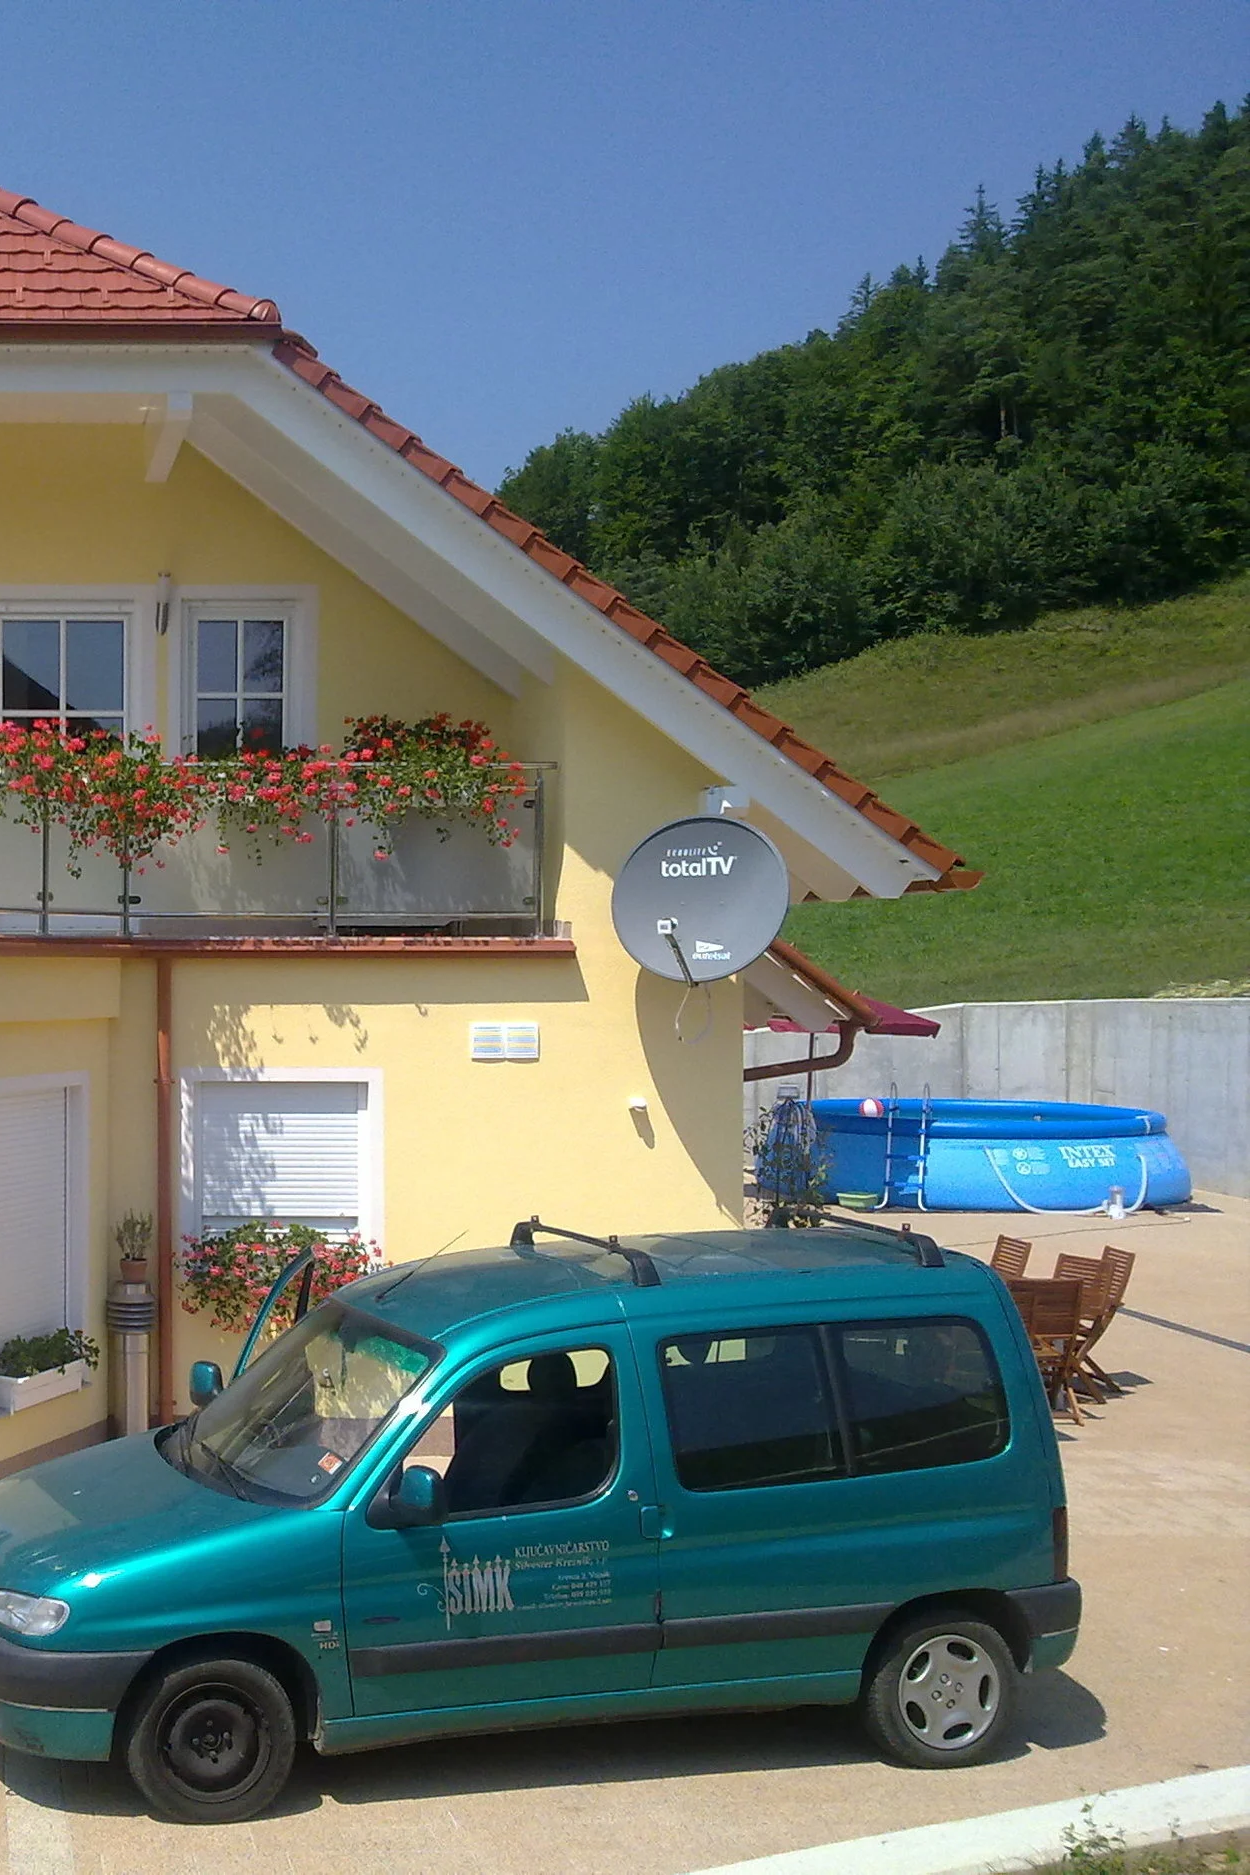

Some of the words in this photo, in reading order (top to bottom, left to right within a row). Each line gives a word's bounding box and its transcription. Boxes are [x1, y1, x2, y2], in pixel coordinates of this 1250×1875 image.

[661, 856, 735, 877] totalTV
[1058, 1146, 1116, 1159] INTEX
[1068, 1159, 1095, 1168] EASY
[446, 1558, 515, 1614] SIMK
